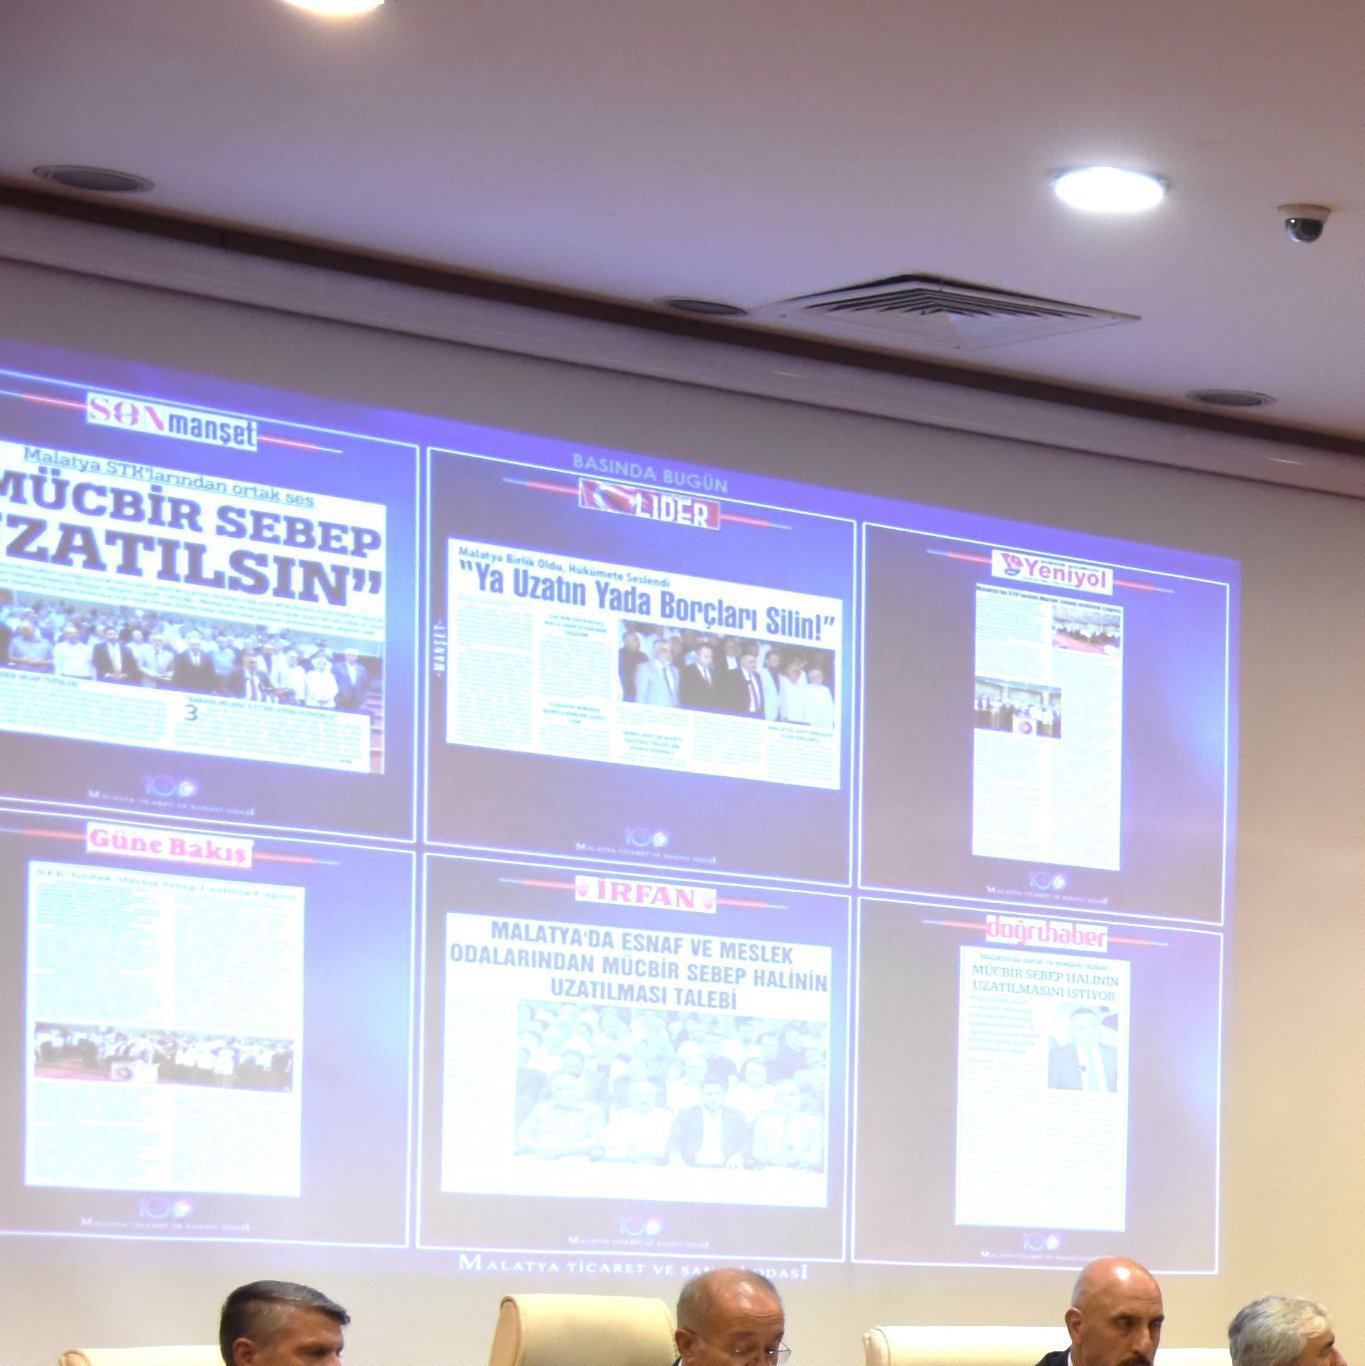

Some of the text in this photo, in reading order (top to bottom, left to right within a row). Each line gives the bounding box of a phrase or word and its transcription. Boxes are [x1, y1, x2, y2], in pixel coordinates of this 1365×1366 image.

[24, 446, 100, 473] Malatya
[232, 483, 281, 503] ortak
[286, 493, 315, 508] ses
[573, 453, 728, 494] BASINDA BUGÜN
[216, 504, 383, 558] SEBEP
[0, 513, 383, 607] ZATILSIN”
[458, 546, 504, 564] Malatya
[506, 553, 535, 568] Birlik
[568, 564, 624, 582] Hükümete
[626, 572, 670, 588] Seslendi
[1024, 557, 1107, 588] Yeniyol
[512, 568, 587, 607] Uzatın
[594, 581, 651, 616] Yada
[660, 590, 758, 631] Borçları
[89, 828, 247, 865] Güne Bakış
[491, 920, 794, 965] MALATYA'DA ESNAF VE MESLEK
[450, 943, 829, 993] ODALARINDAN MÜCBİR SEBEP HALİNİN
[551, 977, 738, 1011] UZATILMASI TALEBİ
[459, 1253, 560, 1273] MALATYA
[567, 1259, 647, 1276] TİCARET
[653, 1263, 675, 1276] VE
